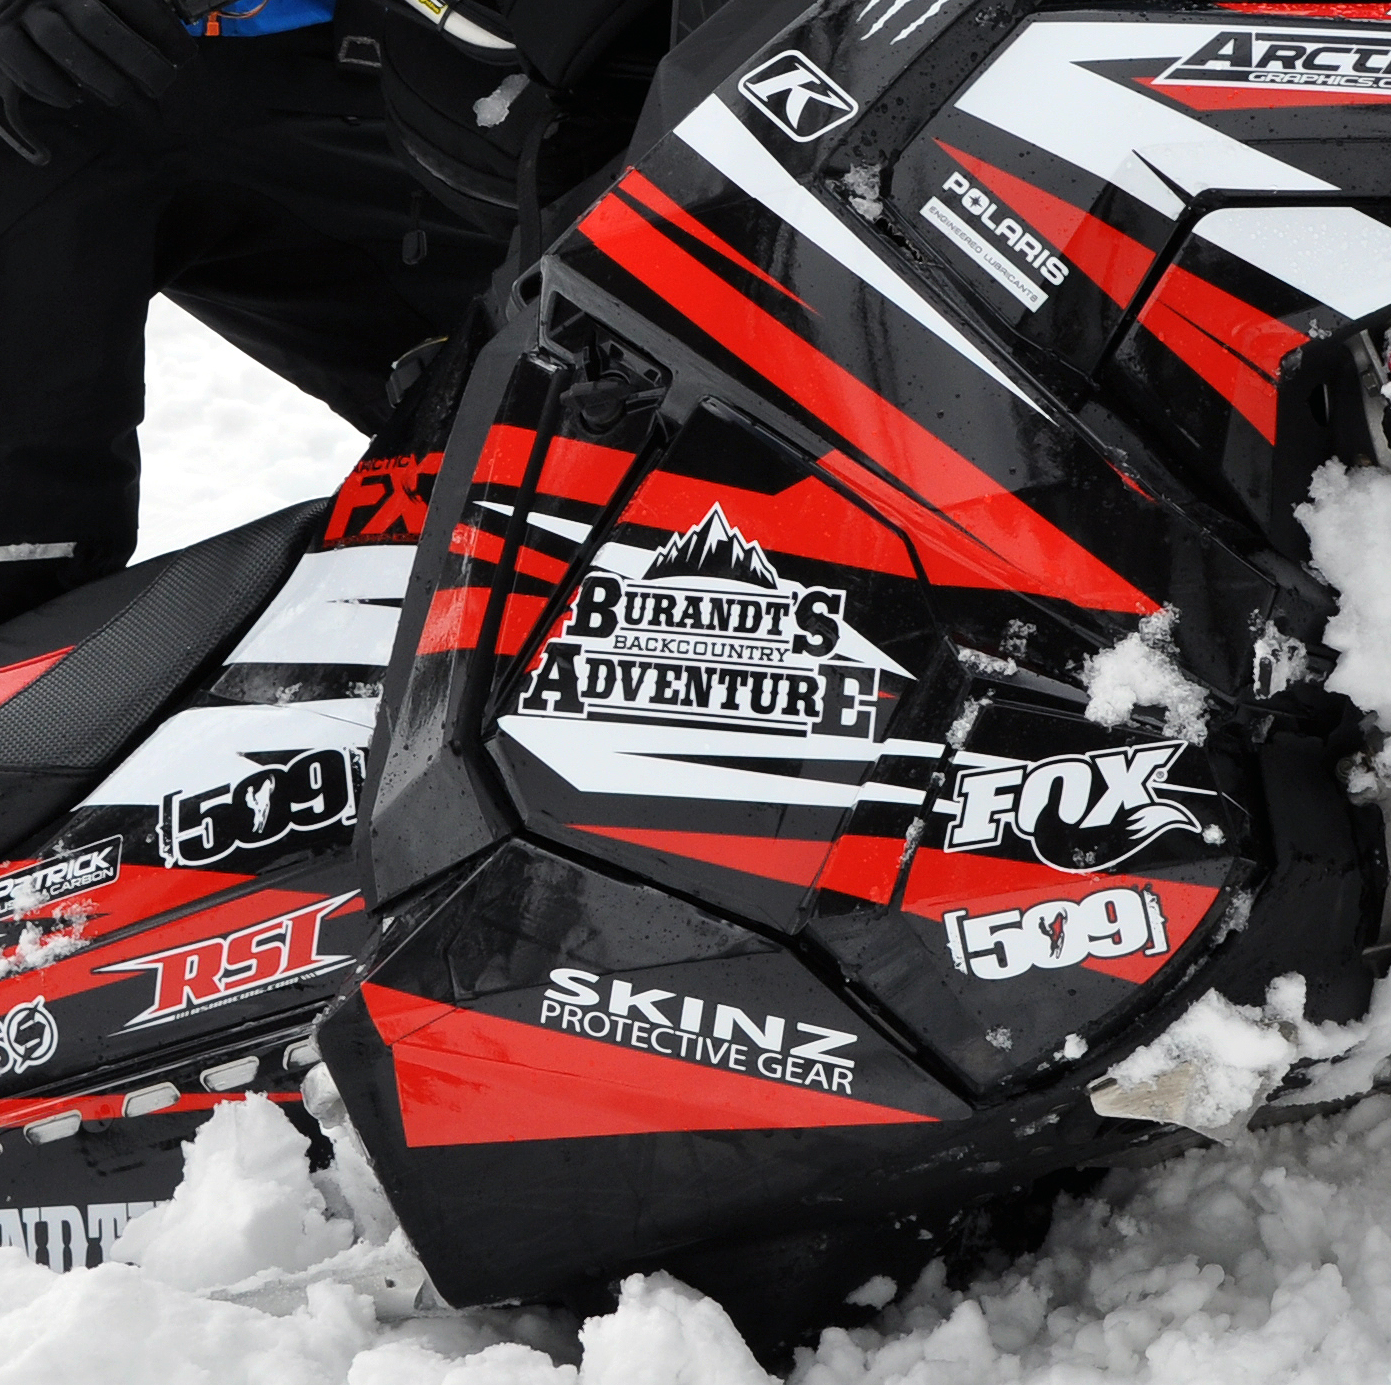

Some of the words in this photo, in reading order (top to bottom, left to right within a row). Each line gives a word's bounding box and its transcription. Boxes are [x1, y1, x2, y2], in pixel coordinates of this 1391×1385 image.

[928, 205, 983, 254] ENGINEERED
[983, 253, 1038, 303] LUBRICANTS
[942, 171, 1070, 286] POLARIS
[522, 642, 876, 739] ADVENTURE
[612, 635, 791, 663] BACKCOUNTRY
[49, 867, 114, 896] CARBON
[108, 892, 348, 1023] RSI
[540, 1000, 748, 1071] PROTECTIVE
[757, 1052, 854, 1095] GEAR
[543, 968, 858, 1068] SKINZ
